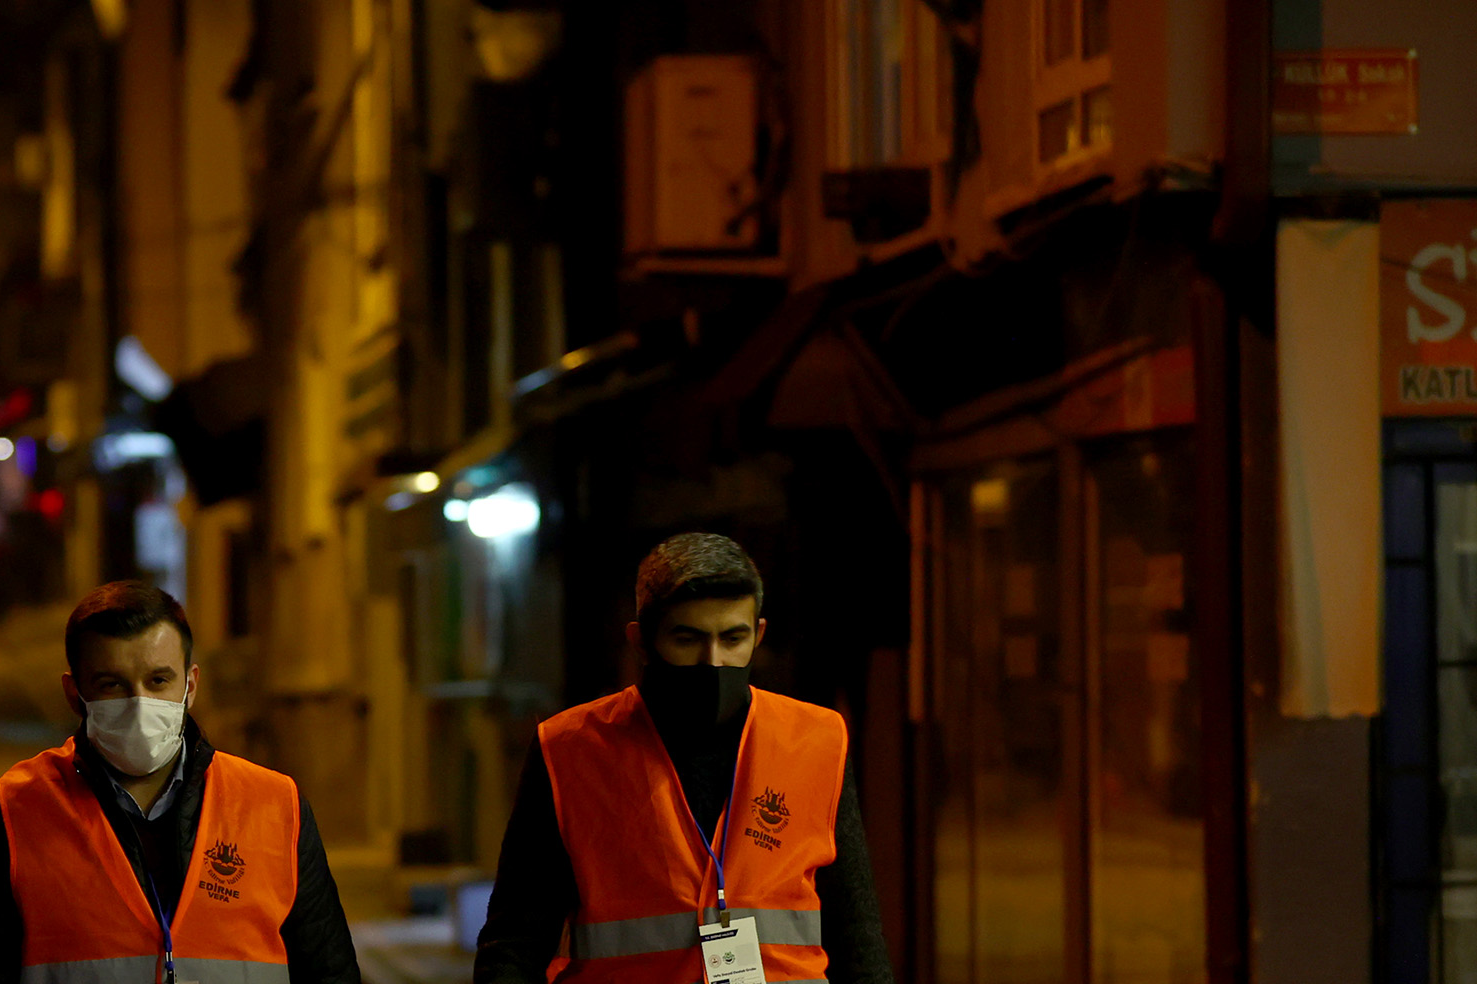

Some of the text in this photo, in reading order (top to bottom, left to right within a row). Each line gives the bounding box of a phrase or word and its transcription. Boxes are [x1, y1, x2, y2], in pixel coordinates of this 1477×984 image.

[744, 827, 782, 849] EDİRNE
[198, 880, 240, 899] EDİRNE
[208, 891, 230, 903] VEFA
